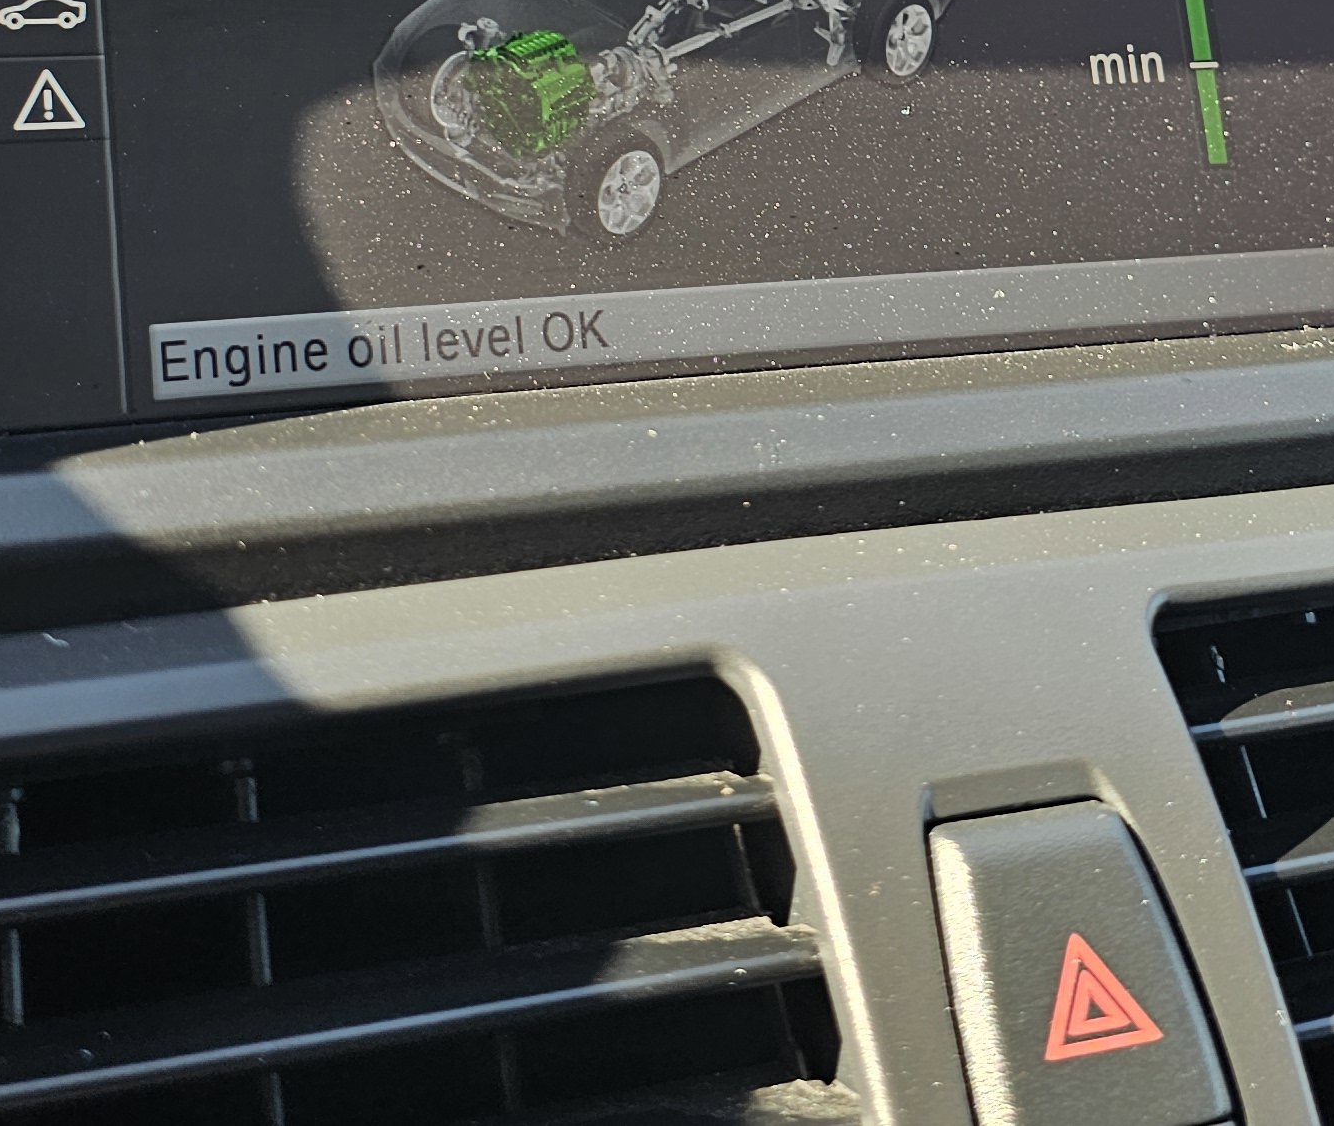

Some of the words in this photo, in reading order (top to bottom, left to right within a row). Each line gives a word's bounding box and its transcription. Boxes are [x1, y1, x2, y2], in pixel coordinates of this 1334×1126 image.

[1089, 44, 1165, 86] min
[160, 333, 328, 387] Engine
[348, 323, 403, 368] oil
[422, 314, 524, 363] level
[542, 309, 611, 353] OK
